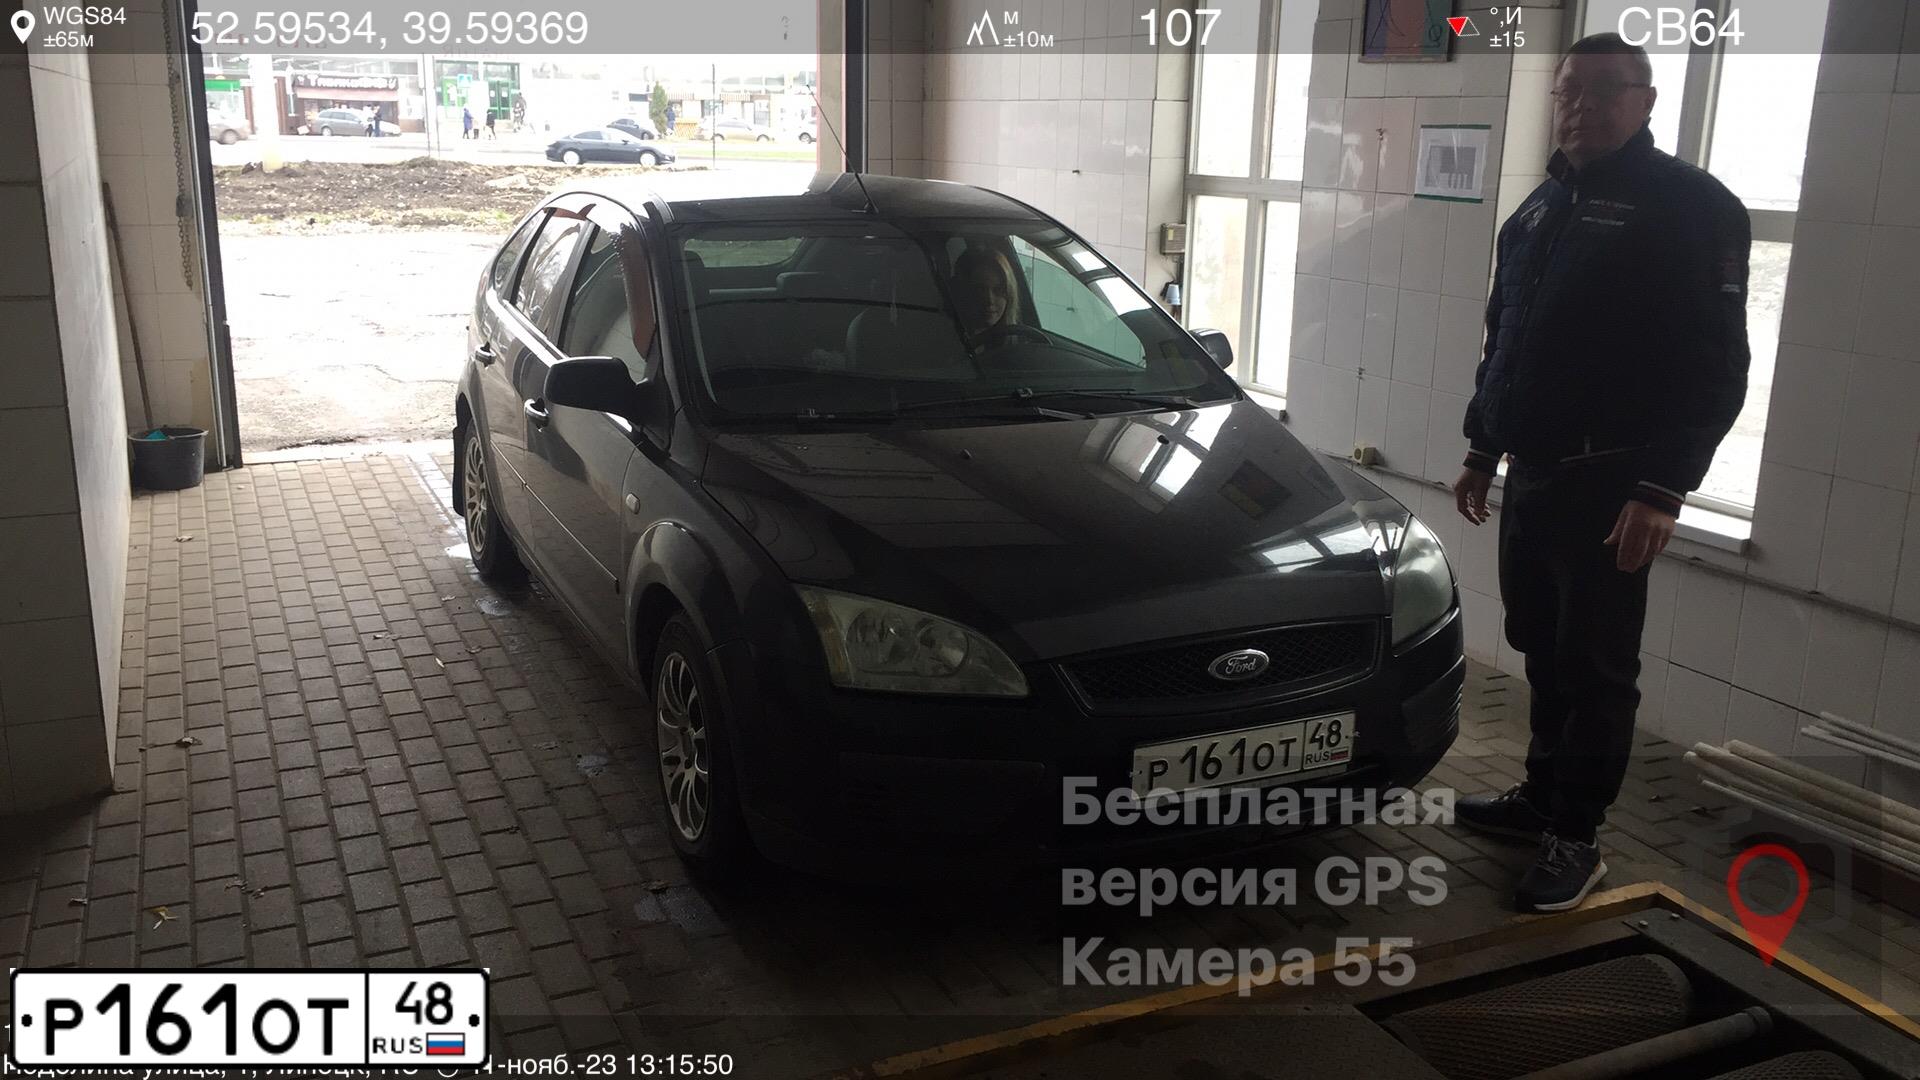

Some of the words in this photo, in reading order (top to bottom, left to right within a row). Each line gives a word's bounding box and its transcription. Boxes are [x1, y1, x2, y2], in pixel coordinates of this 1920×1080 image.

[1226, 656, 1256, 674] Ford
[1309, 719, 1342, 750] 48
[1305, 751, 1330, 765] RUS
